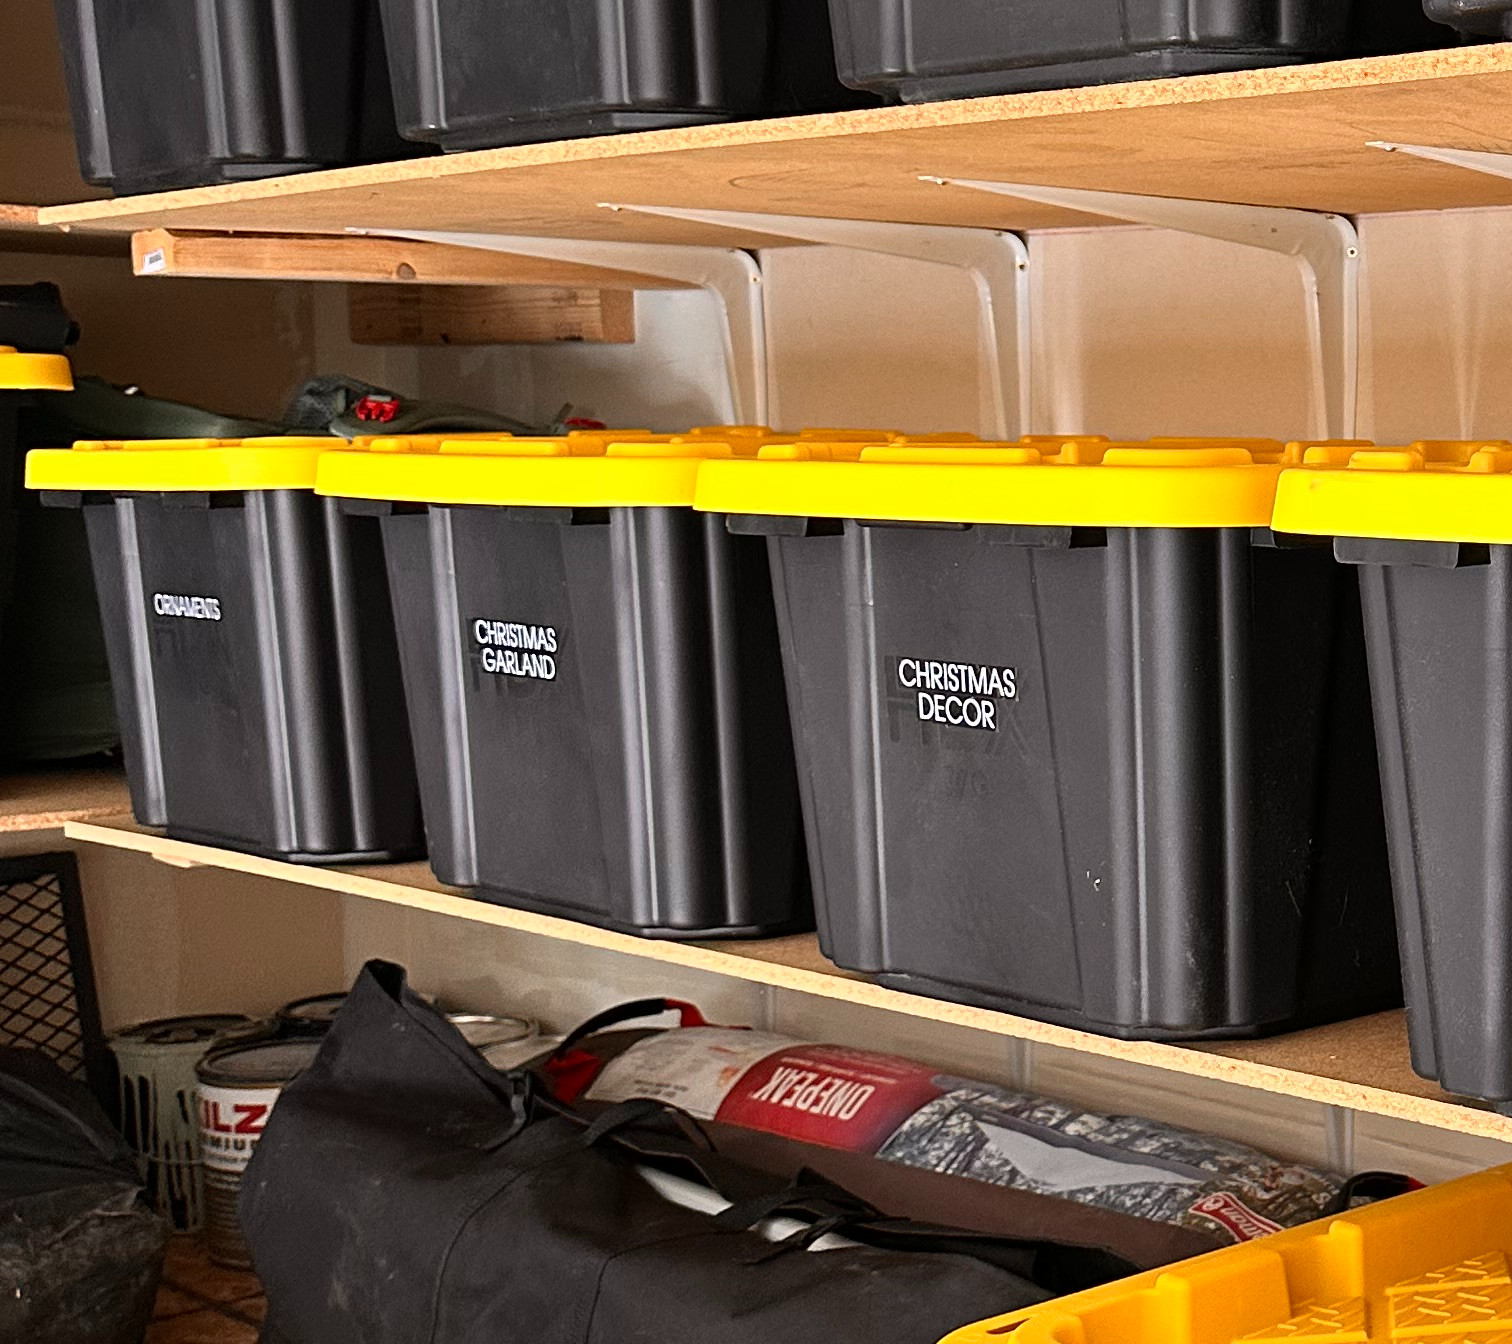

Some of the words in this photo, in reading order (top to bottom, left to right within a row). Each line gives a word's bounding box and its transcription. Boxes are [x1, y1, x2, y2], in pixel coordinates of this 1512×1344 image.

[475, 619, 558, 653] CHRISTMAS
[482, 647, 556, 680] GARLAND
[898, 658, 1016, 698] CHRISTMAS
[917, 691, 996, 730] DECOR
[751, 1066, 876, 1121] ONEPEAK
[199, 1099, 268, 1134] ILZ
